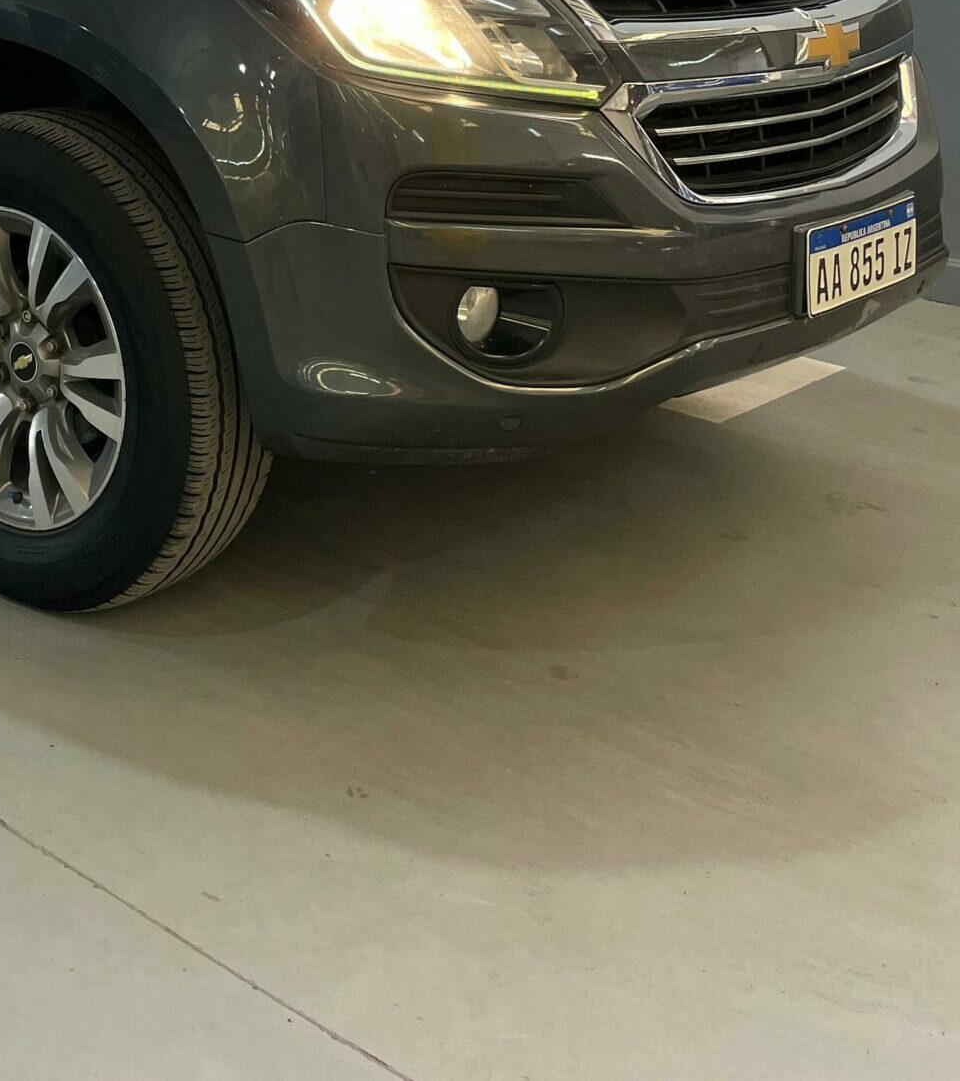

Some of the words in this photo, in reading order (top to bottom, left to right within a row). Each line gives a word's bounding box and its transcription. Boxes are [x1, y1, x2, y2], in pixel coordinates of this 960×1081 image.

[867, 218, 891, 235] ARGENTINA
[816, 253, 842, 304] AA
[850, 237, 885, 291] 855
[893, 227, 912, 275] IZ
